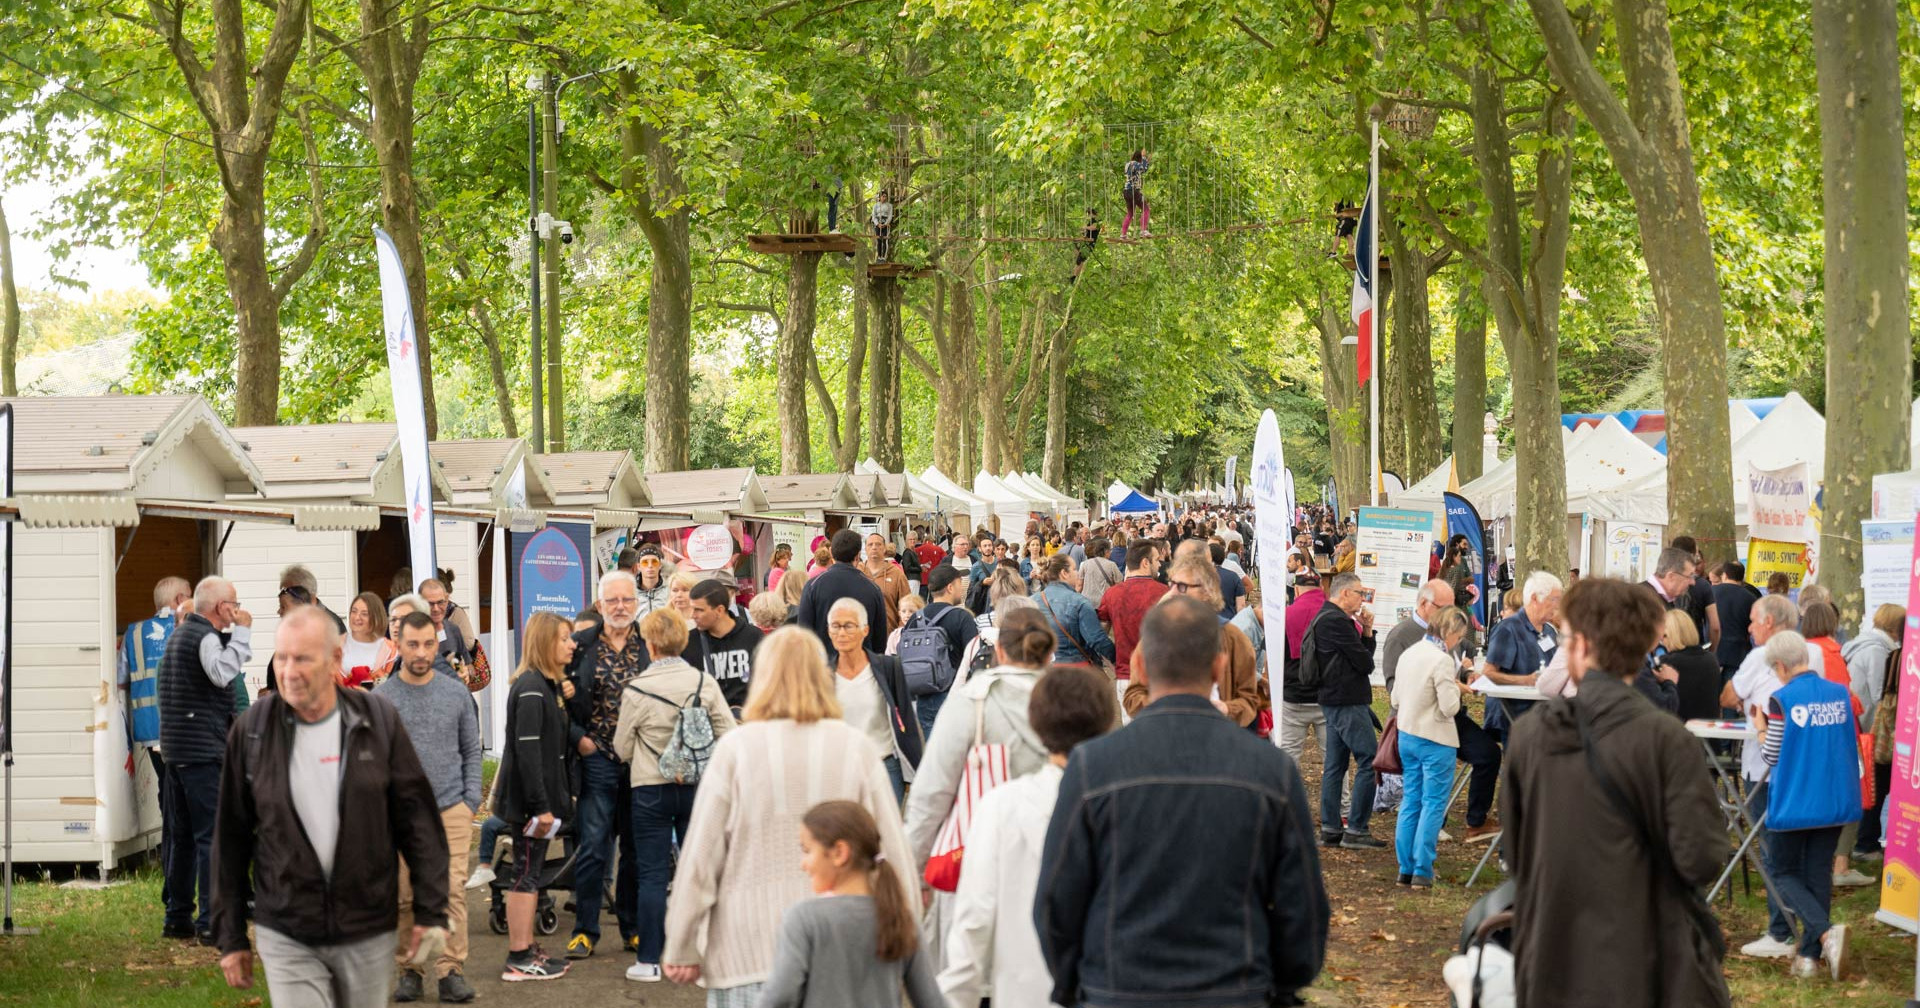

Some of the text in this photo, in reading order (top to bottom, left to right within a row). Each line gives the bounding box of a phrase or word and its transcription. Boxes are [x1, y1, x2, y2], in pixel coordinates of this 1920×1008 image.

[1757, 550, 1776, 563] PIANO
[536, 593, 571, 604] Ensemble,
[1807, 700, 1846, 714] FRANCE
[1810, 712, 1841, 727] ADOT
